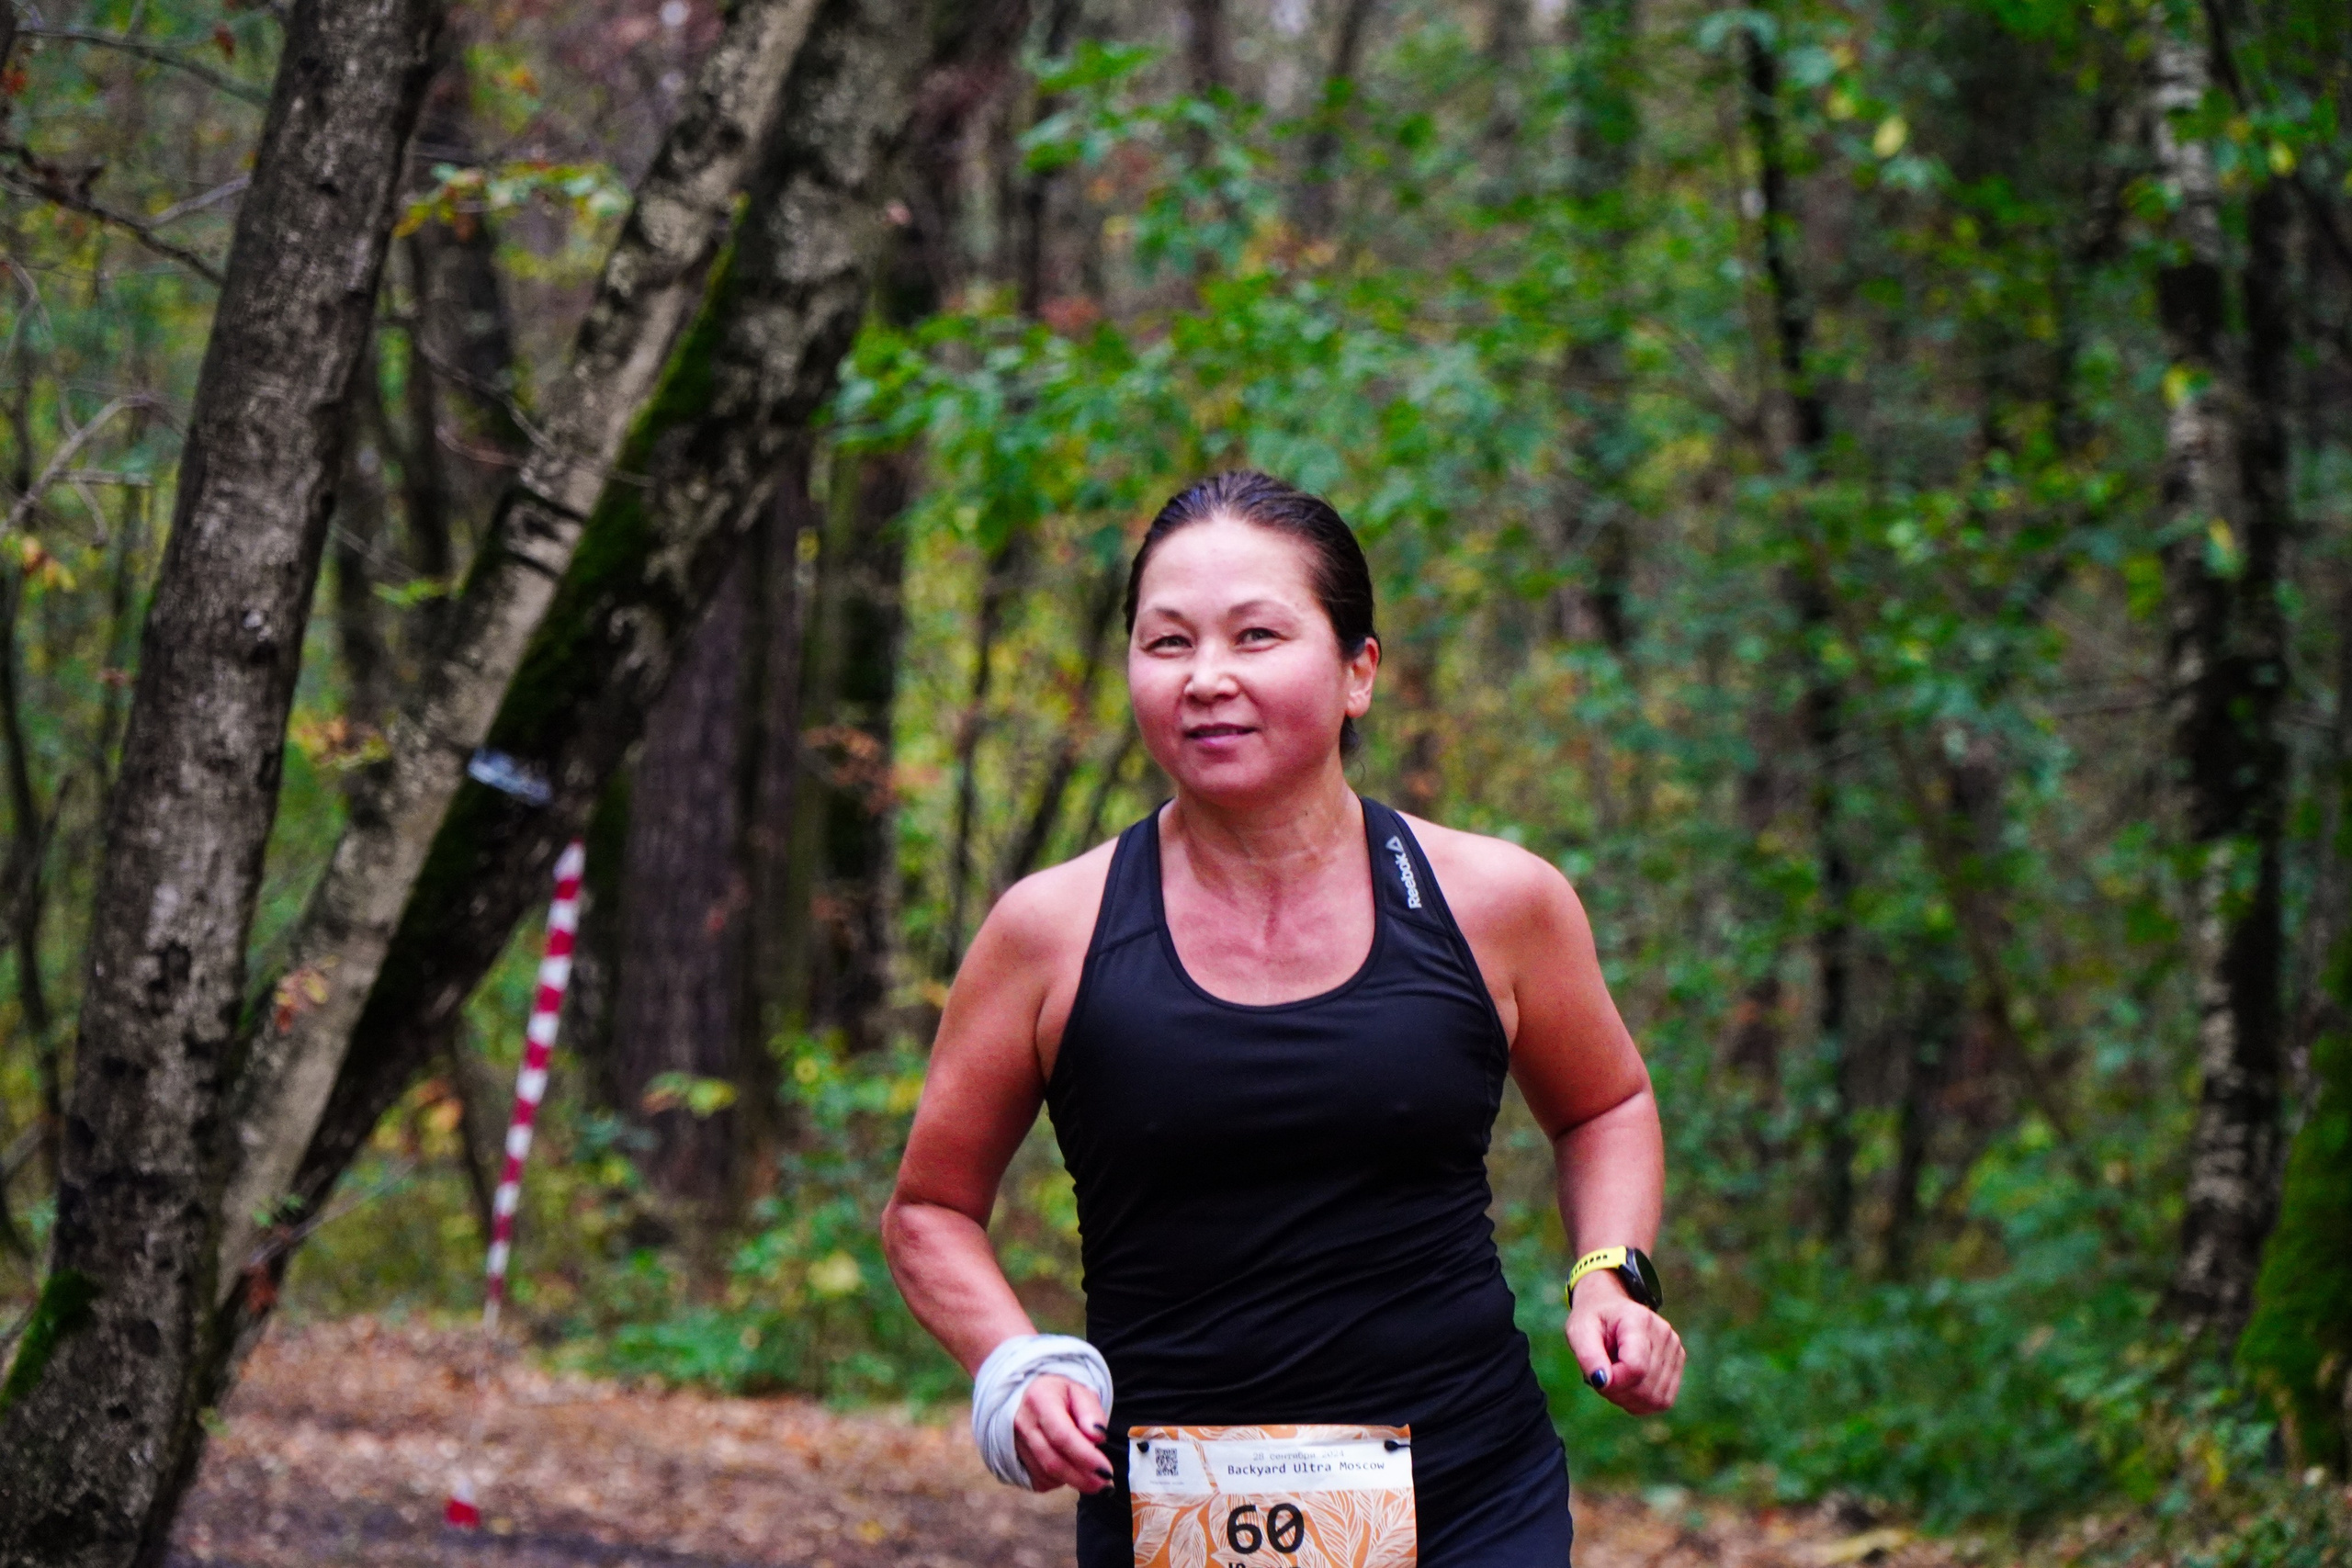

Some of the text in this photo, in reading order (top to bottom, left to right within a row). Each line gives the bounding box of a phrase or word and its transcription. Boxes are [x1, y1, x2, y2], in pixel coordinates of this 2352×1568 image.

[1395, 852, 1422, 908] Reebok
[1227, 1461, 1385, 1476] Backyard Ultra Moscow
[1253, 1451, 1264, 1461] 28
[1227, 1503, 1305, 1555] 60
